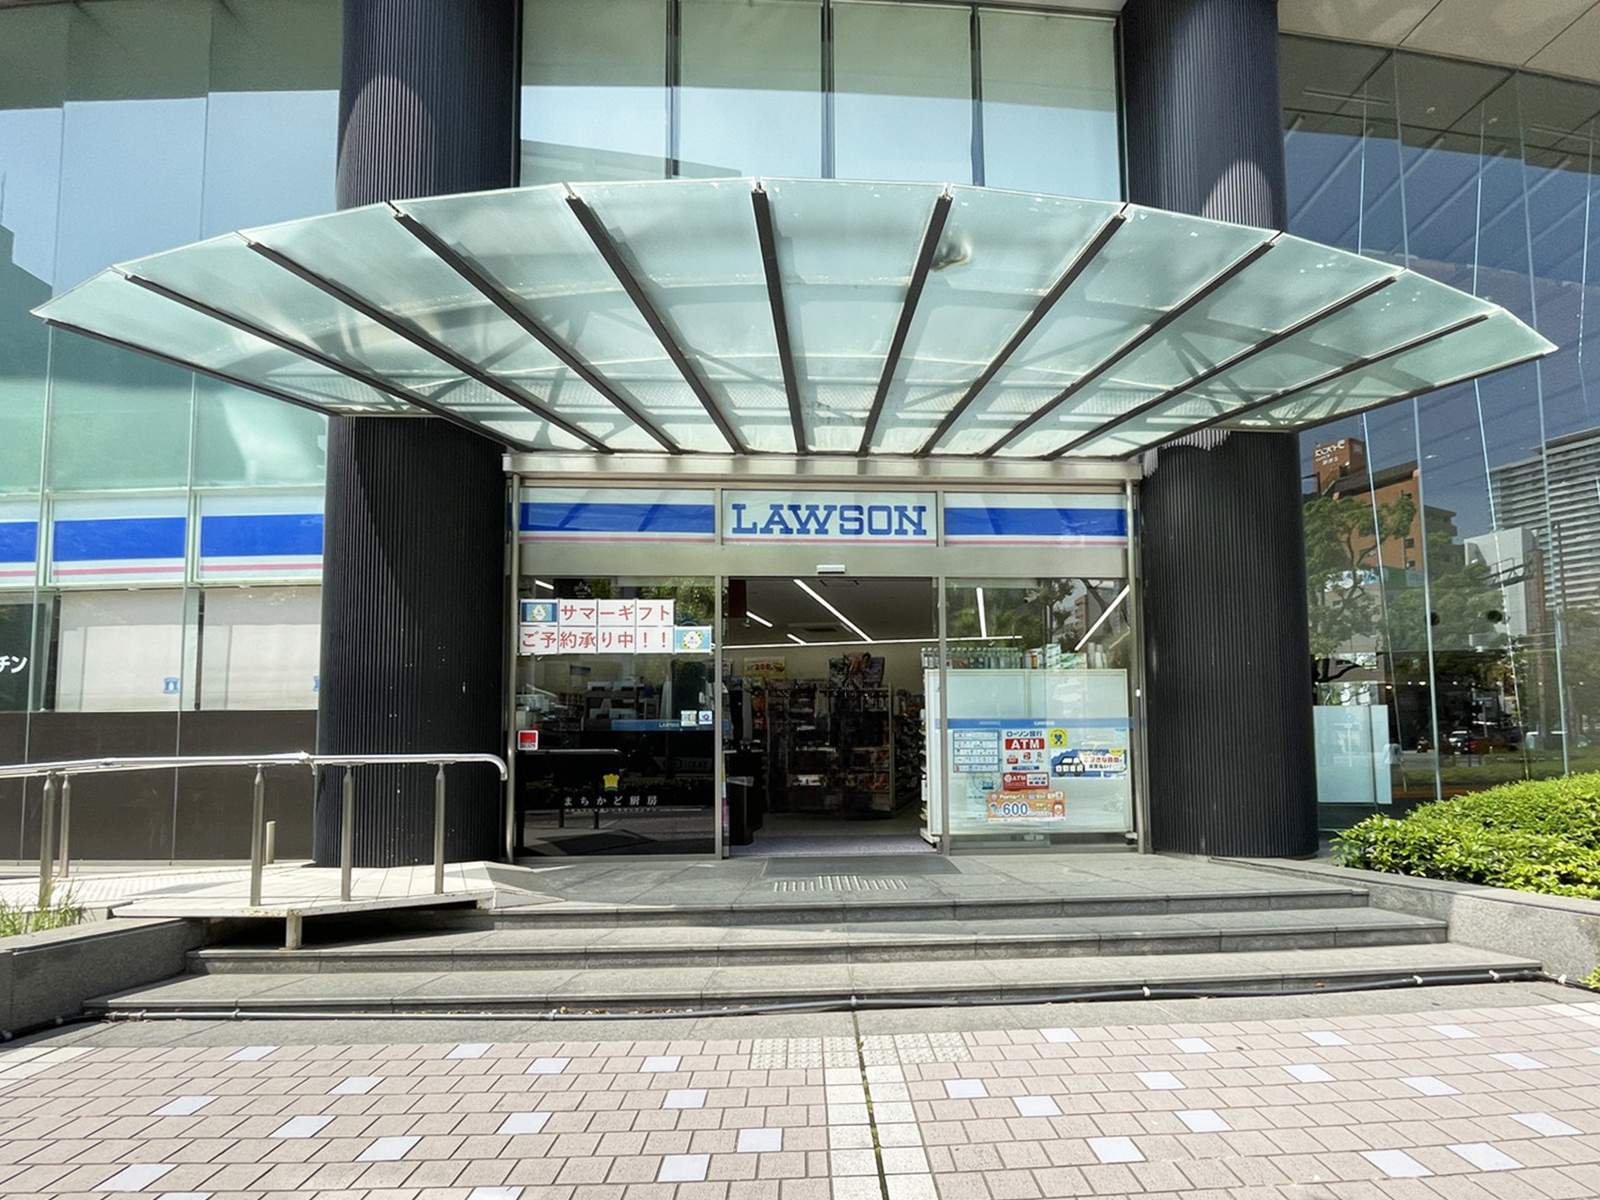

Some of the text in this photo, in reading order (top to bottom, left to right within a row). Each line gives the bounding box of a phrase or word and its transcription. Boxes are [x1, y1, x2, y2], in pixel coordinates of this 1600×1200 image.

[731, 503, 927, 536] LAWSON
[560, 604, 671, 621] サマーギフト
[521, 631, 667, 649] ご予約承り中！！
[1010, 739, 1040, 749] ATM
[1002, 802, 1029, 816] 600
